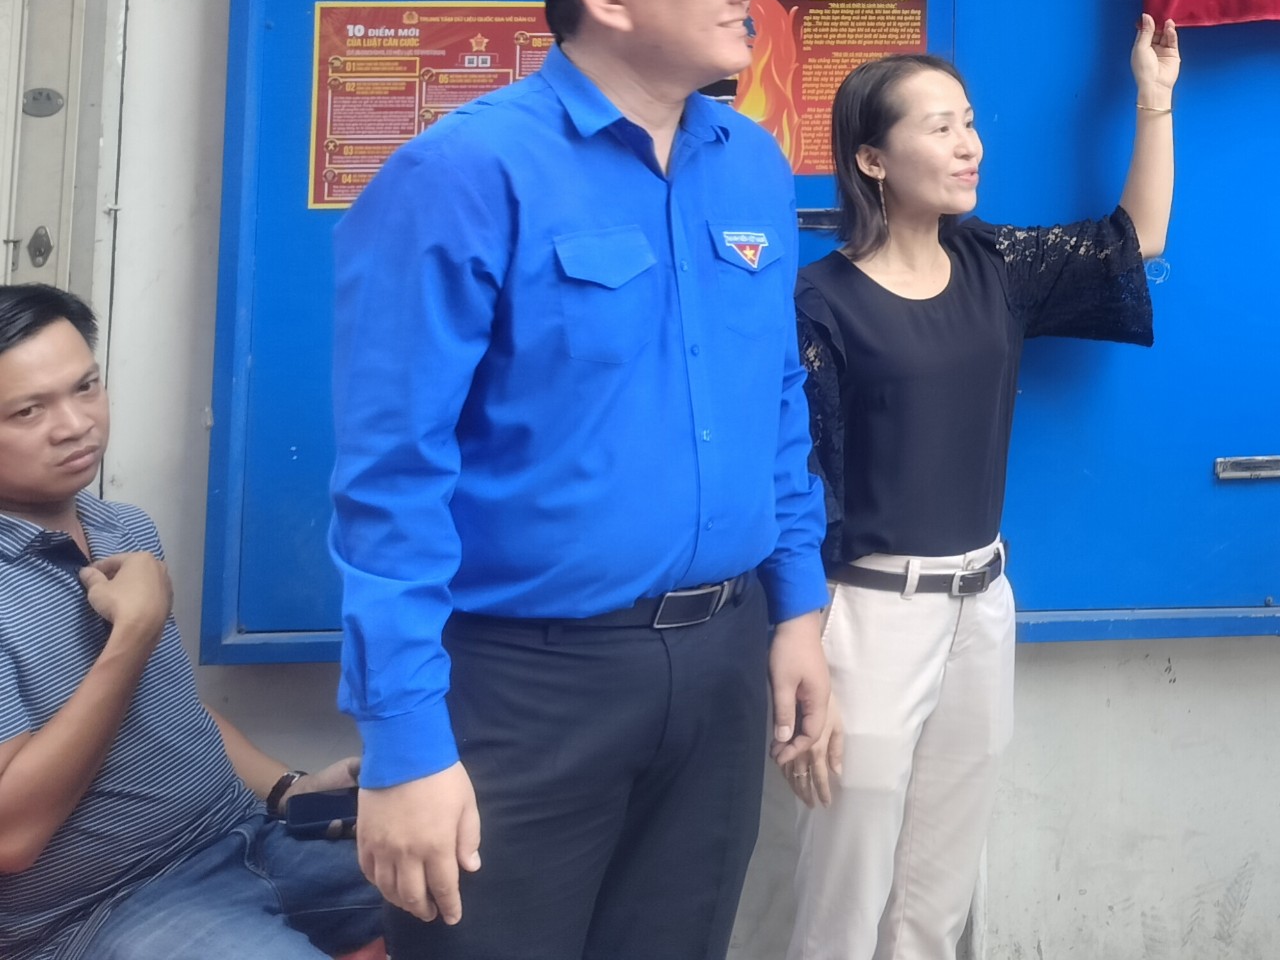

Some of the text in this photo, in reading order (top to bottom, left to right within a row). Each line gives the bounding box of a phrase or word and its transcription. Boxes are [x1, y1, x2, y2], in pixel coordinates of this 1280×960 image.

[346, 24, 365, 37] 10
[346, 82, 356, 92] 02
[341, 174, 352, 184] 04
